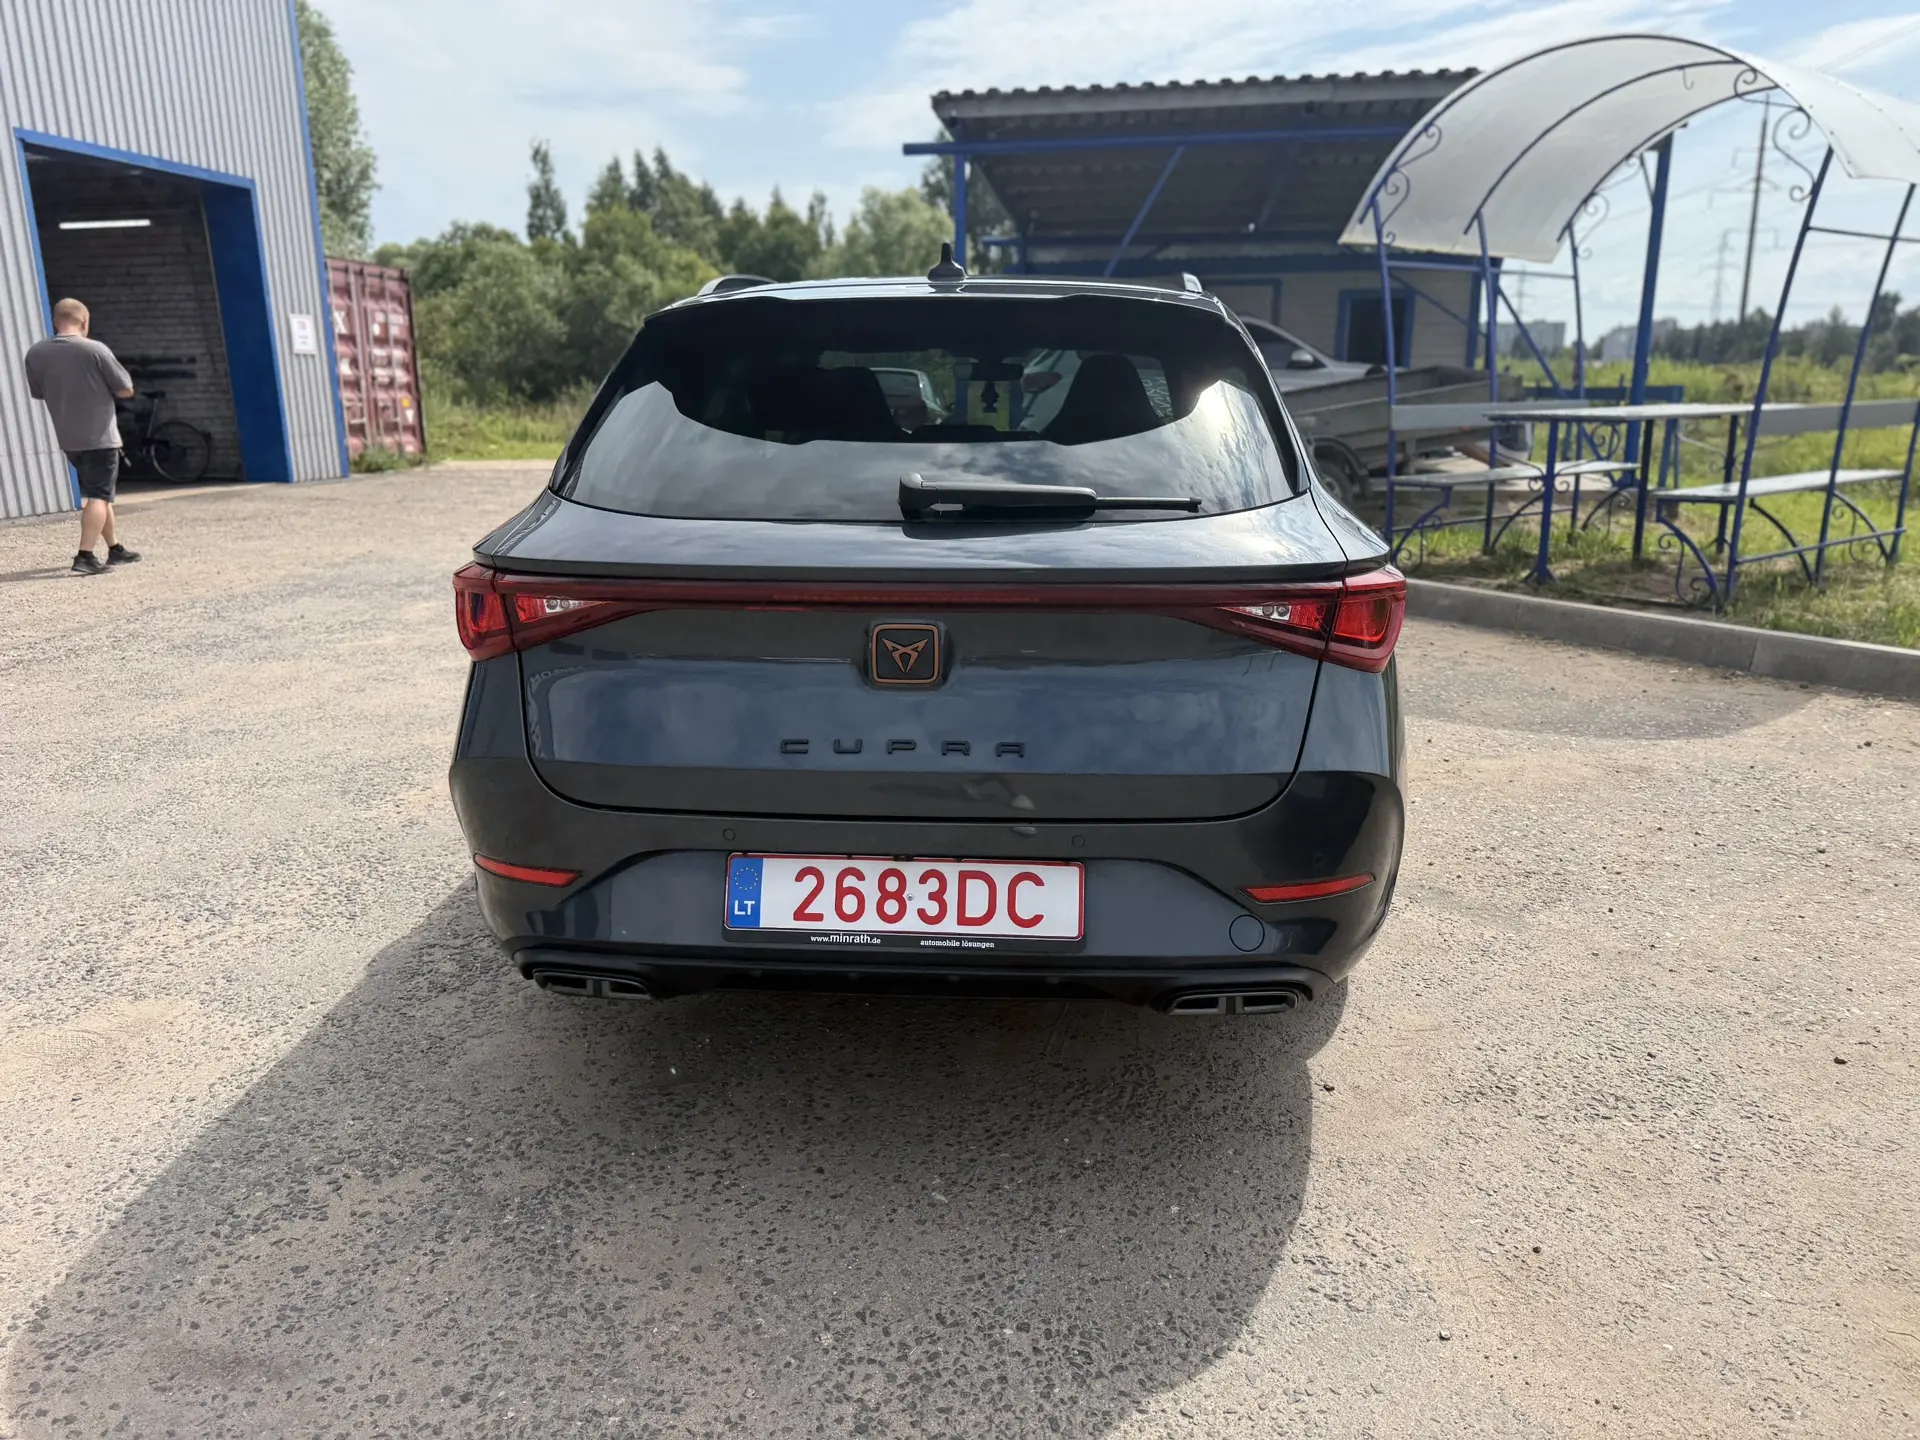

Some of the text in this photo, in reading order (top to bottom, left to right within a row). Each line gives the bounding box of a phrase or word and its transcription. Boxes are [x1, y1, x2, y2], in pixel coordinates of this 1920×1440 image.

[780, 738, 1026, 758] CUPRA
[792, 865, 1046, 929] 2683DC
[733, 899, 756, 917] LT
[810, 933, 882, 945] www.minrath.de
[919, 939, 995, 948] automobile lösungen
